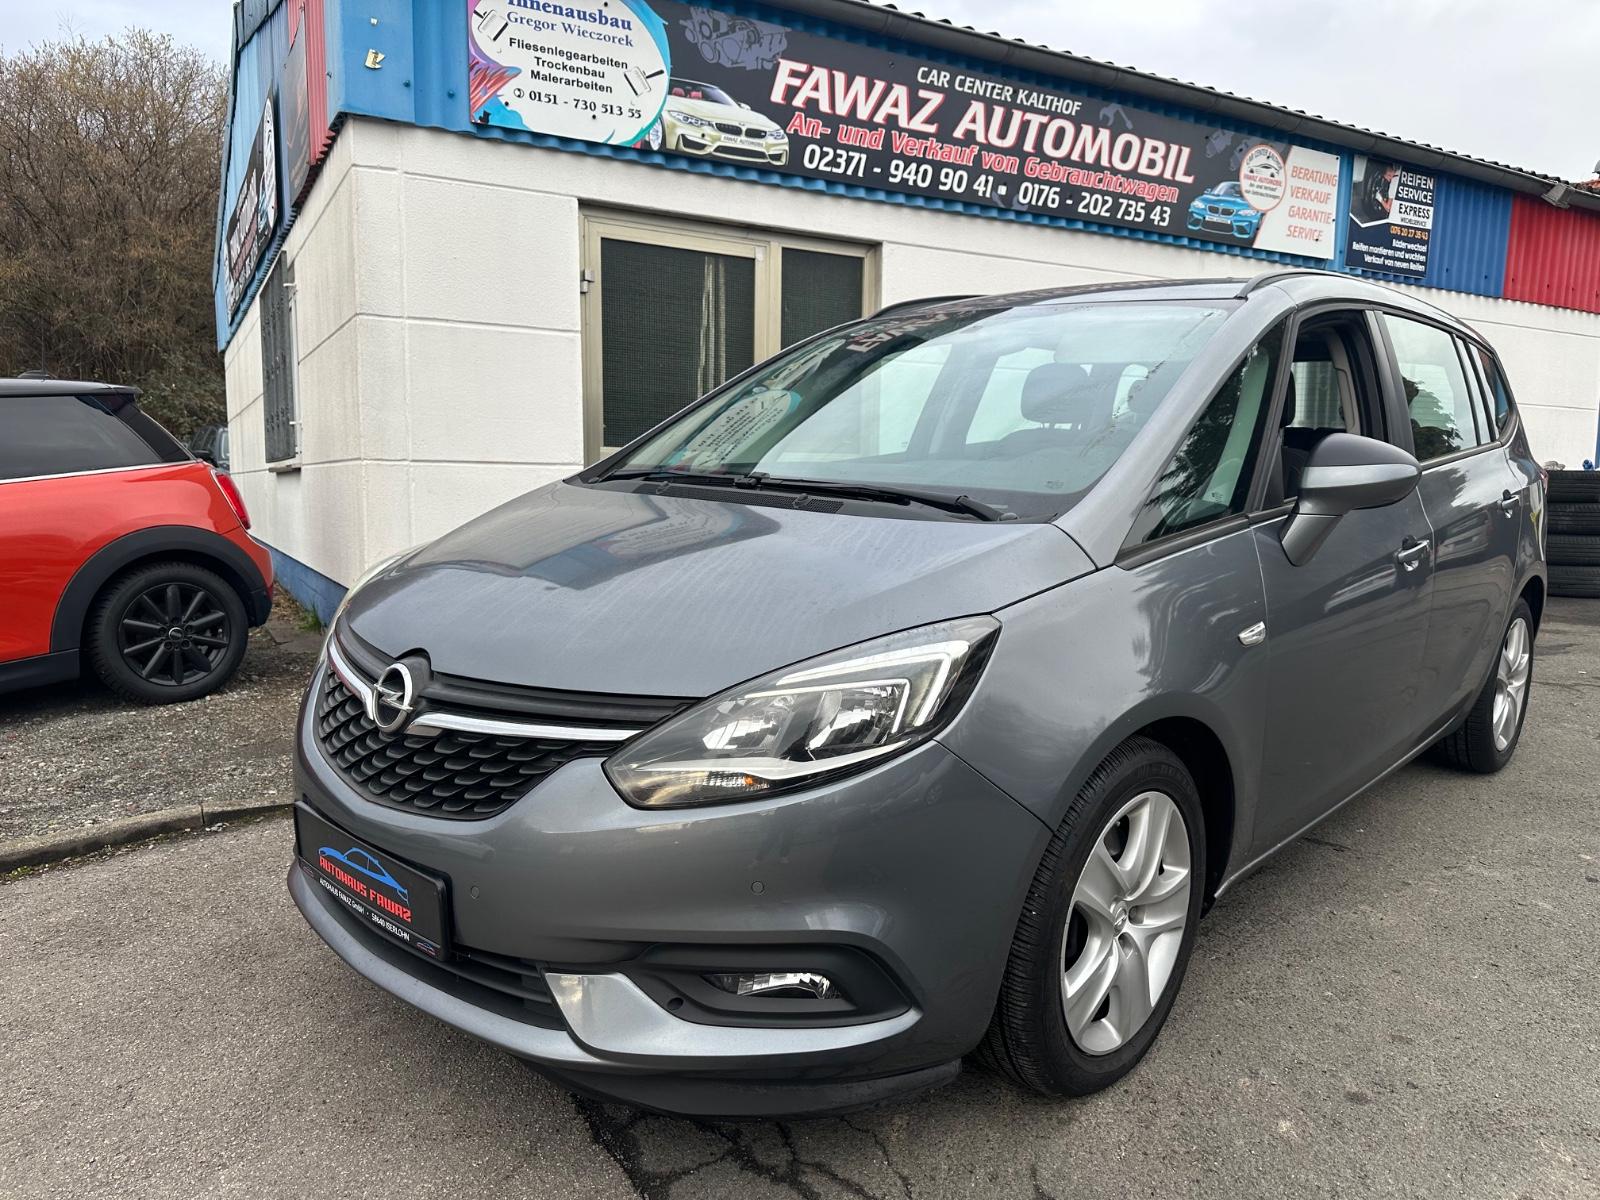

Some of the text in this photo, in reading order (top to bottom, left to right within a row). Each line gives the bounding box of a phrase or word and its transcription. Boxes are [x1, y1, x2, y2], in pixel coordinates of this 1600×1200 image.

[506, 11, 634, 47] Gregor Wieczorek
[509, 37, 628, 69] Fliesenlegearbeiten
[534, 56, 605, 79] Trockenbau
[530, 69, 613, 93] Malerarbeiten
[917, 66, 1082, 117] CAR CENTER KALTHOF
[529, 90, 559, 105] 0151
[573, 98, 596, 112] 730
[601, 103, 623, 116] 513
[627, 107, 642, 119] 55
[769, 57, 1196, 184] FAWAZ AUTOMOBIL
[785, 112, 1179, 203] An- und Verkauf von Gebrauchtwagen
[803, 144, 867, 178] 02371
[889, 160, 932, 188] 940
[939, 169, 968, 194] 90
[973, 174, 994, 198] 41
[1018, 182, 1060, 210] 0176
[1077, 192, 1111, 217] 202
[1116, 198, 1146, 223] 735
[1150, 203, 1171, 227] 43
[1291, 165, 1338, 187] BERATUNG
[1401, 171, 1434, 190] REIFEN
[1290, 185, 1332, 205] VERKAUF
[1398, 186, 1433, 204] SERVICE
[1288, 205, 1333, 224] GARANTIE
[1399, 203, 1430, 220] EXPRESS
[1285, 224, 1324, 241] SERVICE
[319, 856, 413, 923] AUTOHAUS FAWAZ
